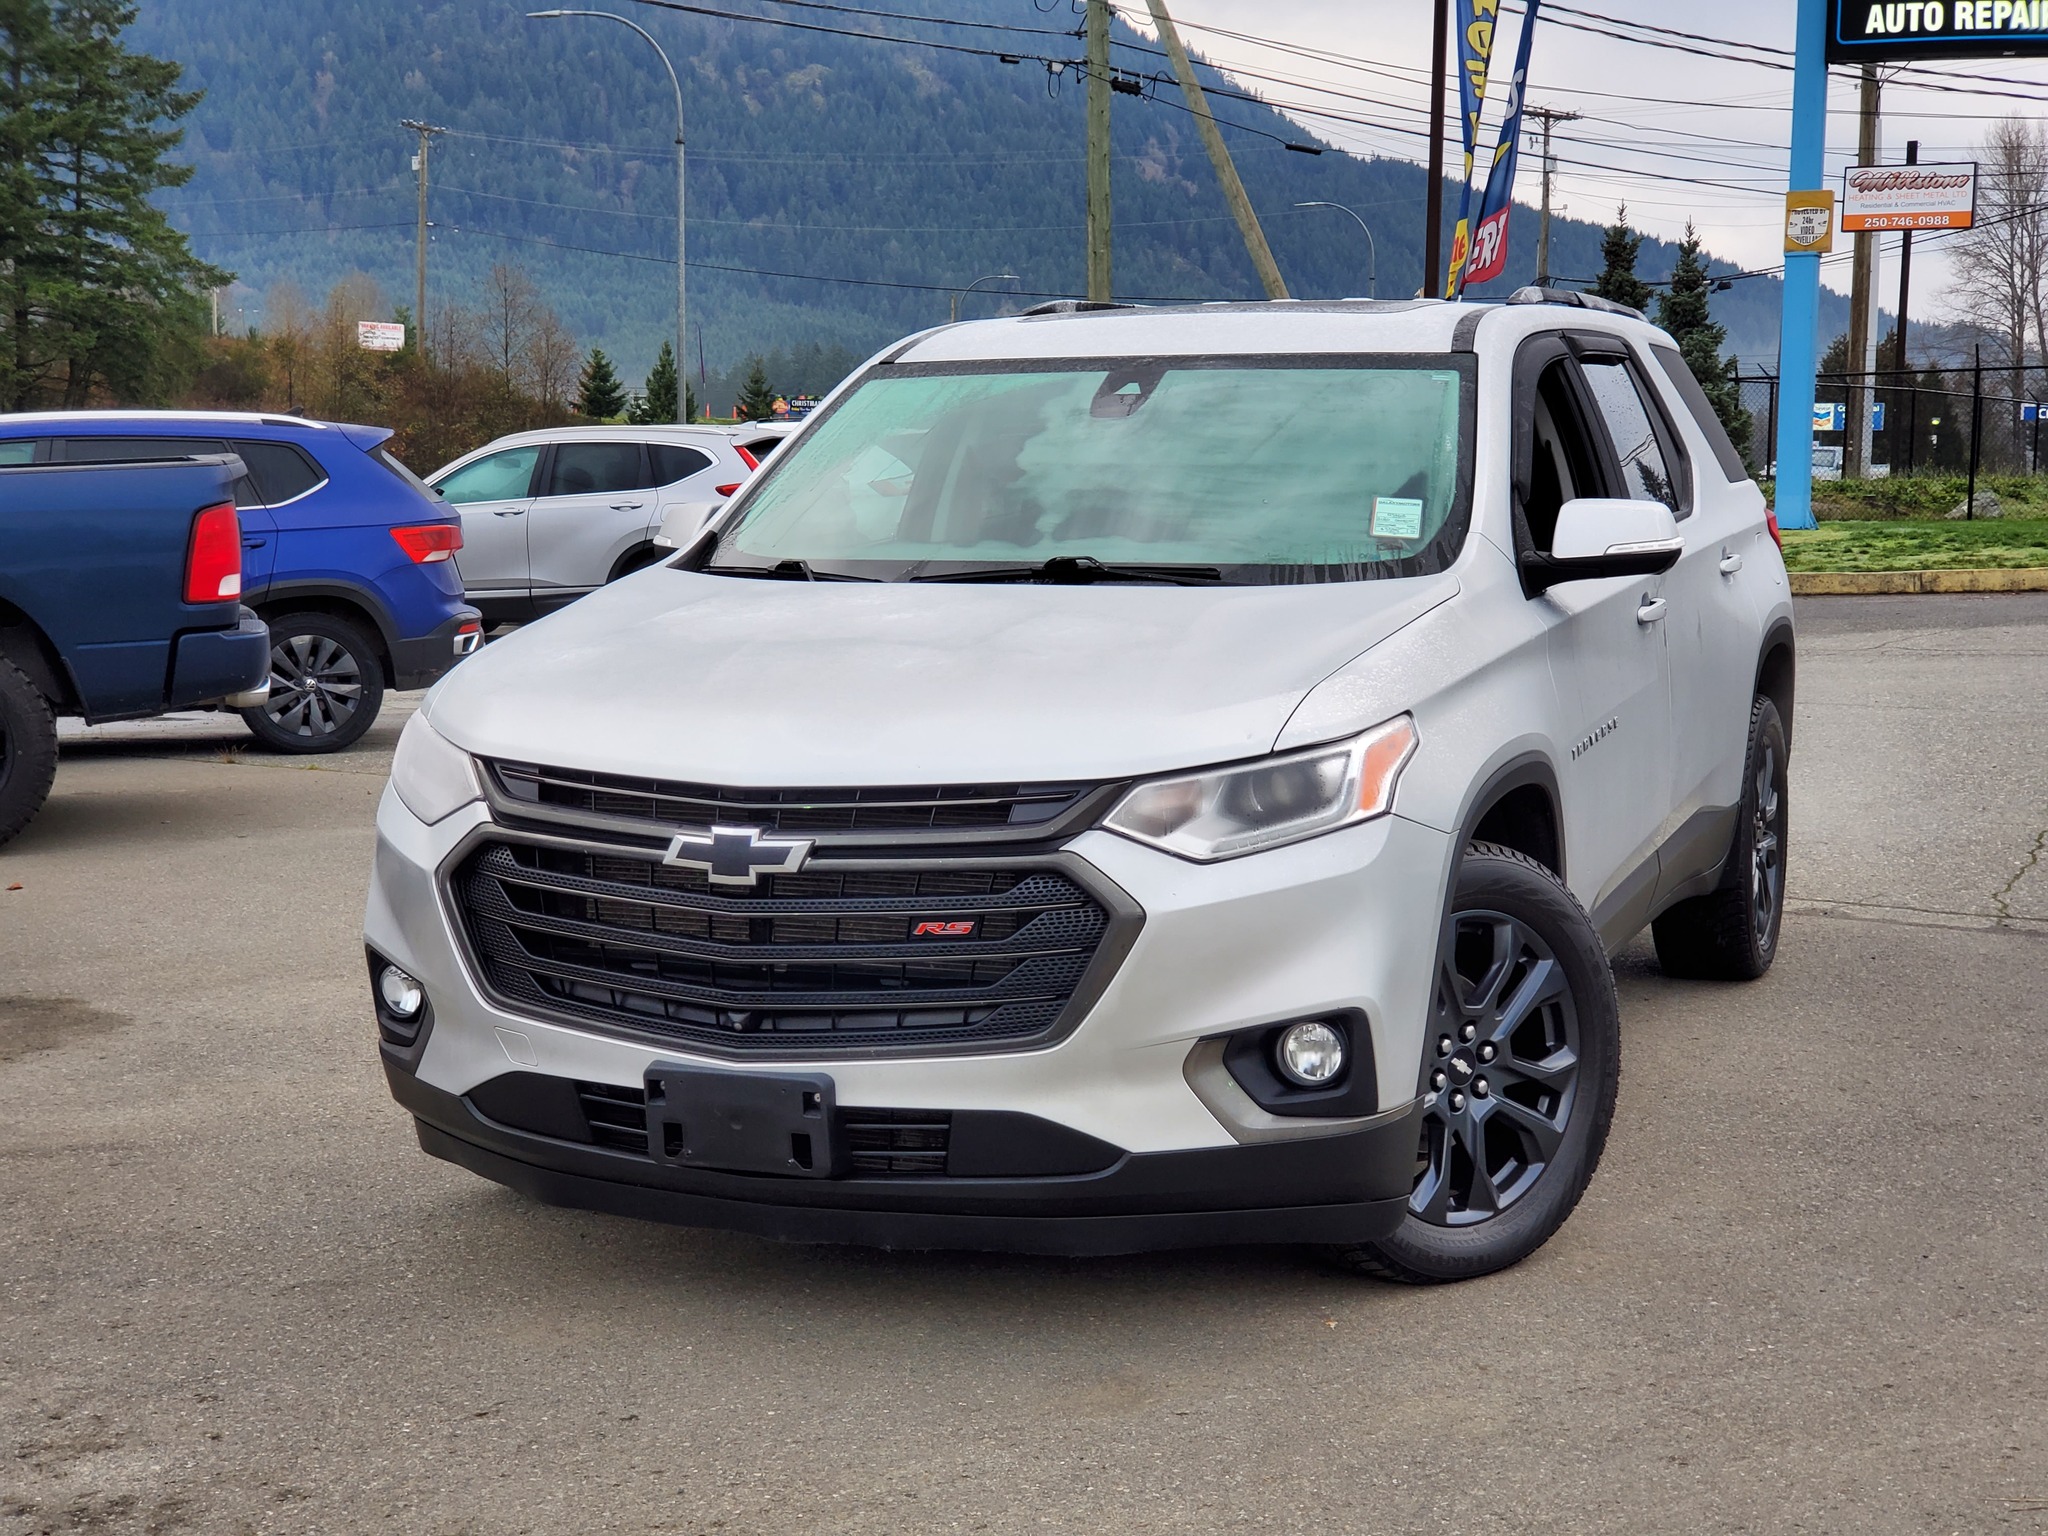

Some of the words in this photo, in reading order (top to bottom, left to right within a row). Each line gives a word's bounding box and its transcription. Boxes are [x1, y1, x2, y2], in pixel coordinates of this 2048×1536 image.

[1864, 1, 1944, 34] AUTO
[1849, 171, 1970, 193] Millstone
[1848, 194, 1884, 202] HEATING
[1895, 192, 1920, 200] SHEET
[1923, 191, 1949, 199] METAL
[1952, 190, 1967, 198] LTD
[1900, 200, 1936, 208] Commercial
[1864, 215, 1950, 228] 250-746-0988
[913, 921, 975, 935] RS
